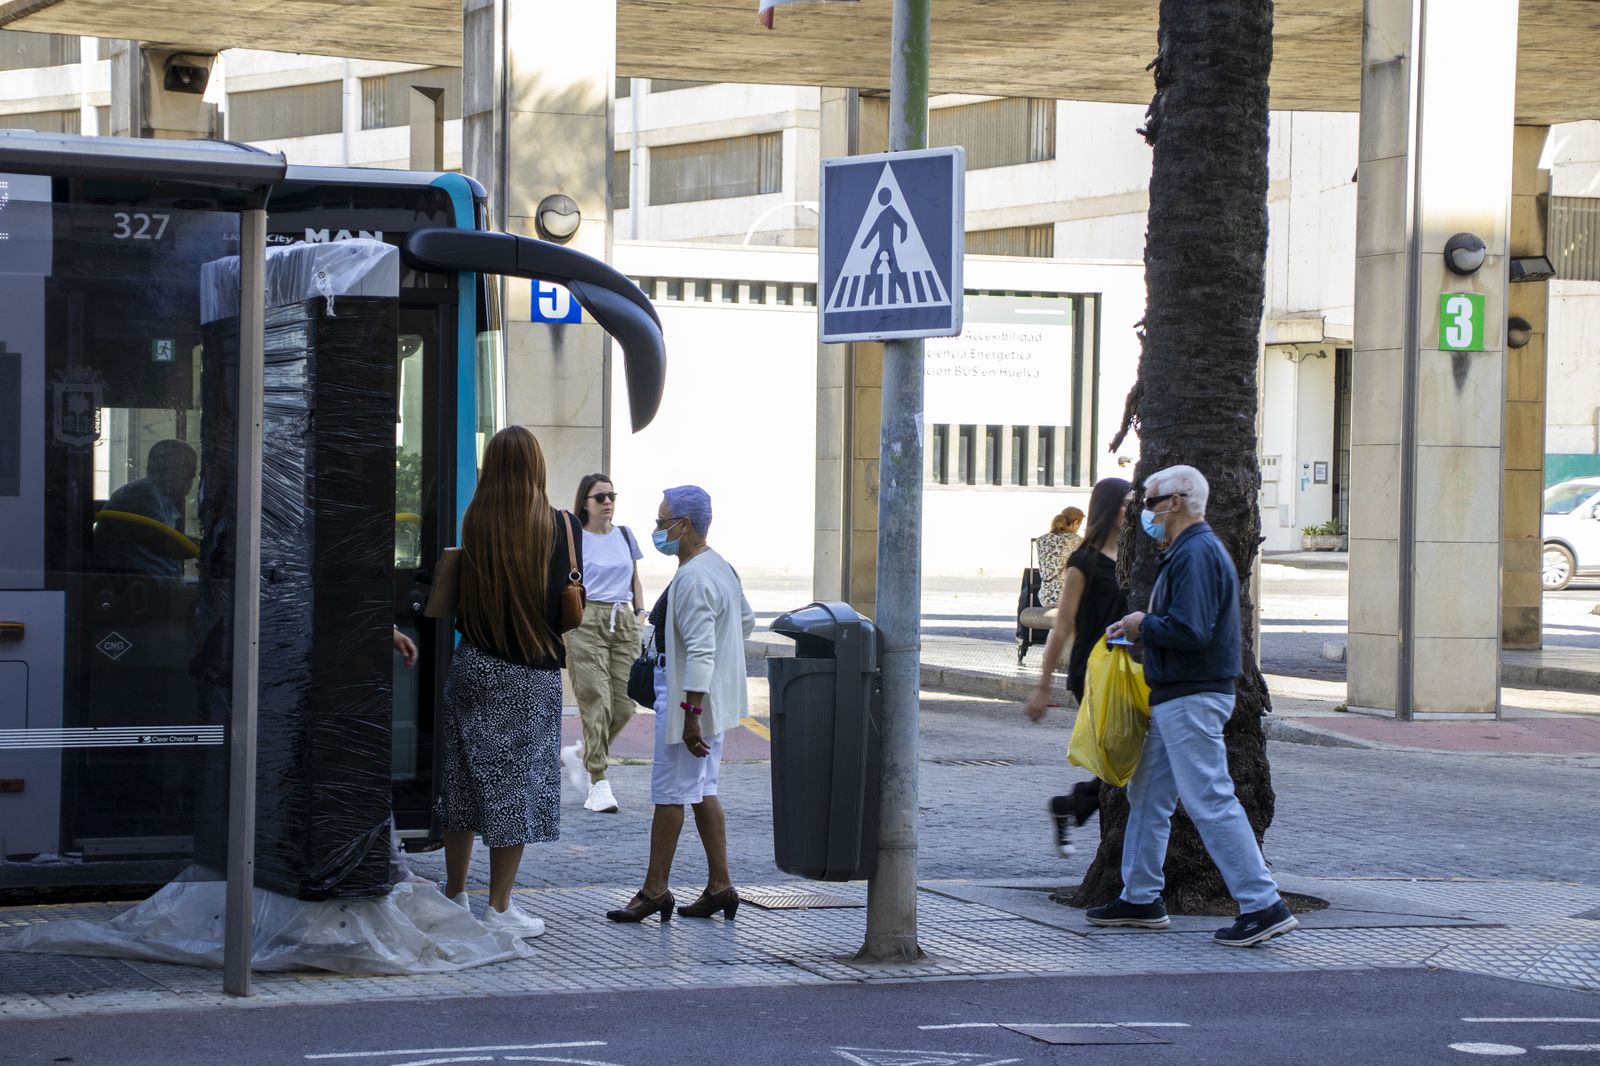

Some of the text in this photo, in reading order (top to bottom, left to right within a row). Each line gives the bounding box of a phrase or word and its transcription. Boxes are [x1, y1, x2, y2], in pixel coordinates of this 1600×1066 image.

[113, 212, 170, 240] 327
[266, 233, 294, 244] City
[304, 227, 384, 243] MAN
[539, 279, 571, 319] 5
[1446, 296, 1473, 348] 3
[965, 330, 1042, 342] Accesibilidad
[926, 349, 967, 360] ciencia
[954, 365, 978, 377] BUS
[999, 367, 1040, 378] Huelva
[103, 641, 125, 650] CNG
